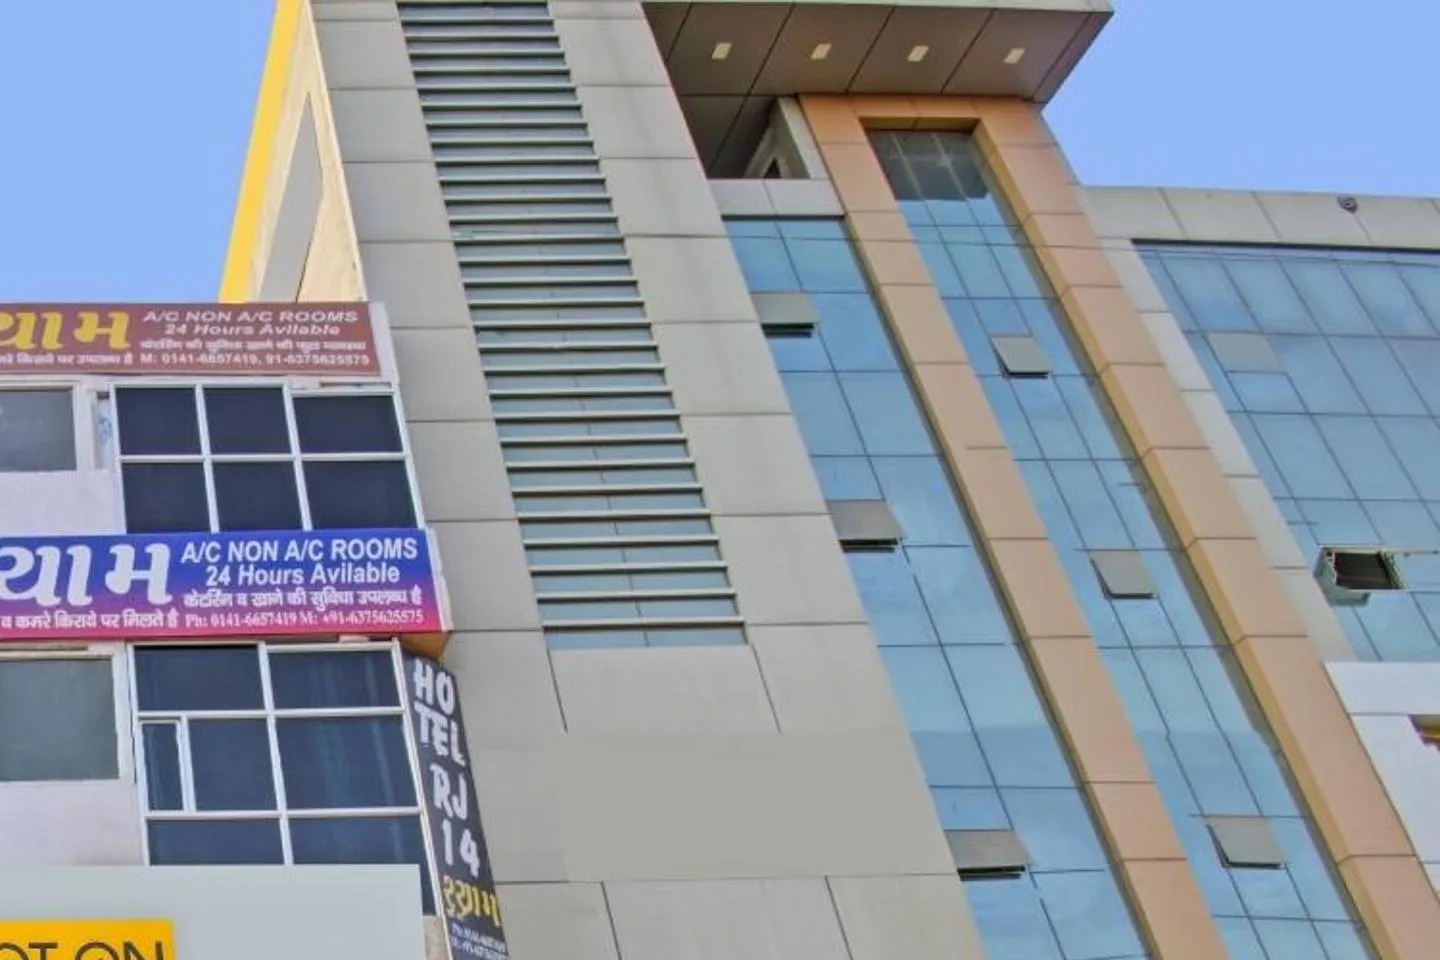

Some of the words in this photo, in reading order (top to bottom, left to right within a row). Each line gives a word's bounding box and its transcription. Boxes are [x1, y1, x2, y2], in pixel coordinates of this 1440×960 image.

[142, 311, 178, 322] A/C
[185, 311, 231, 322] NON
[237, 311, 273, 322] A/C
[279, 310, 358, 322] ROOMS
[164, 324, 187, 336] 24
[193, 324, 253, 336] Hours
[259, 323, 341, 336] Avilable
[181, 542, 221, 563] A/C
[227, 541, 278, 562] NON
[284, 539, 324, 561] A/C
[331, 538, 417, 560] ROOMS
[206, 565, 231, 586] 24
[238, 564, 304, 585] Hours
[311, 562, 400, 584] Avilable
[413, 701, 466, 766] TEL
[430, 763, 468, 821] RJ
[441, 819, 480, 878] 14
